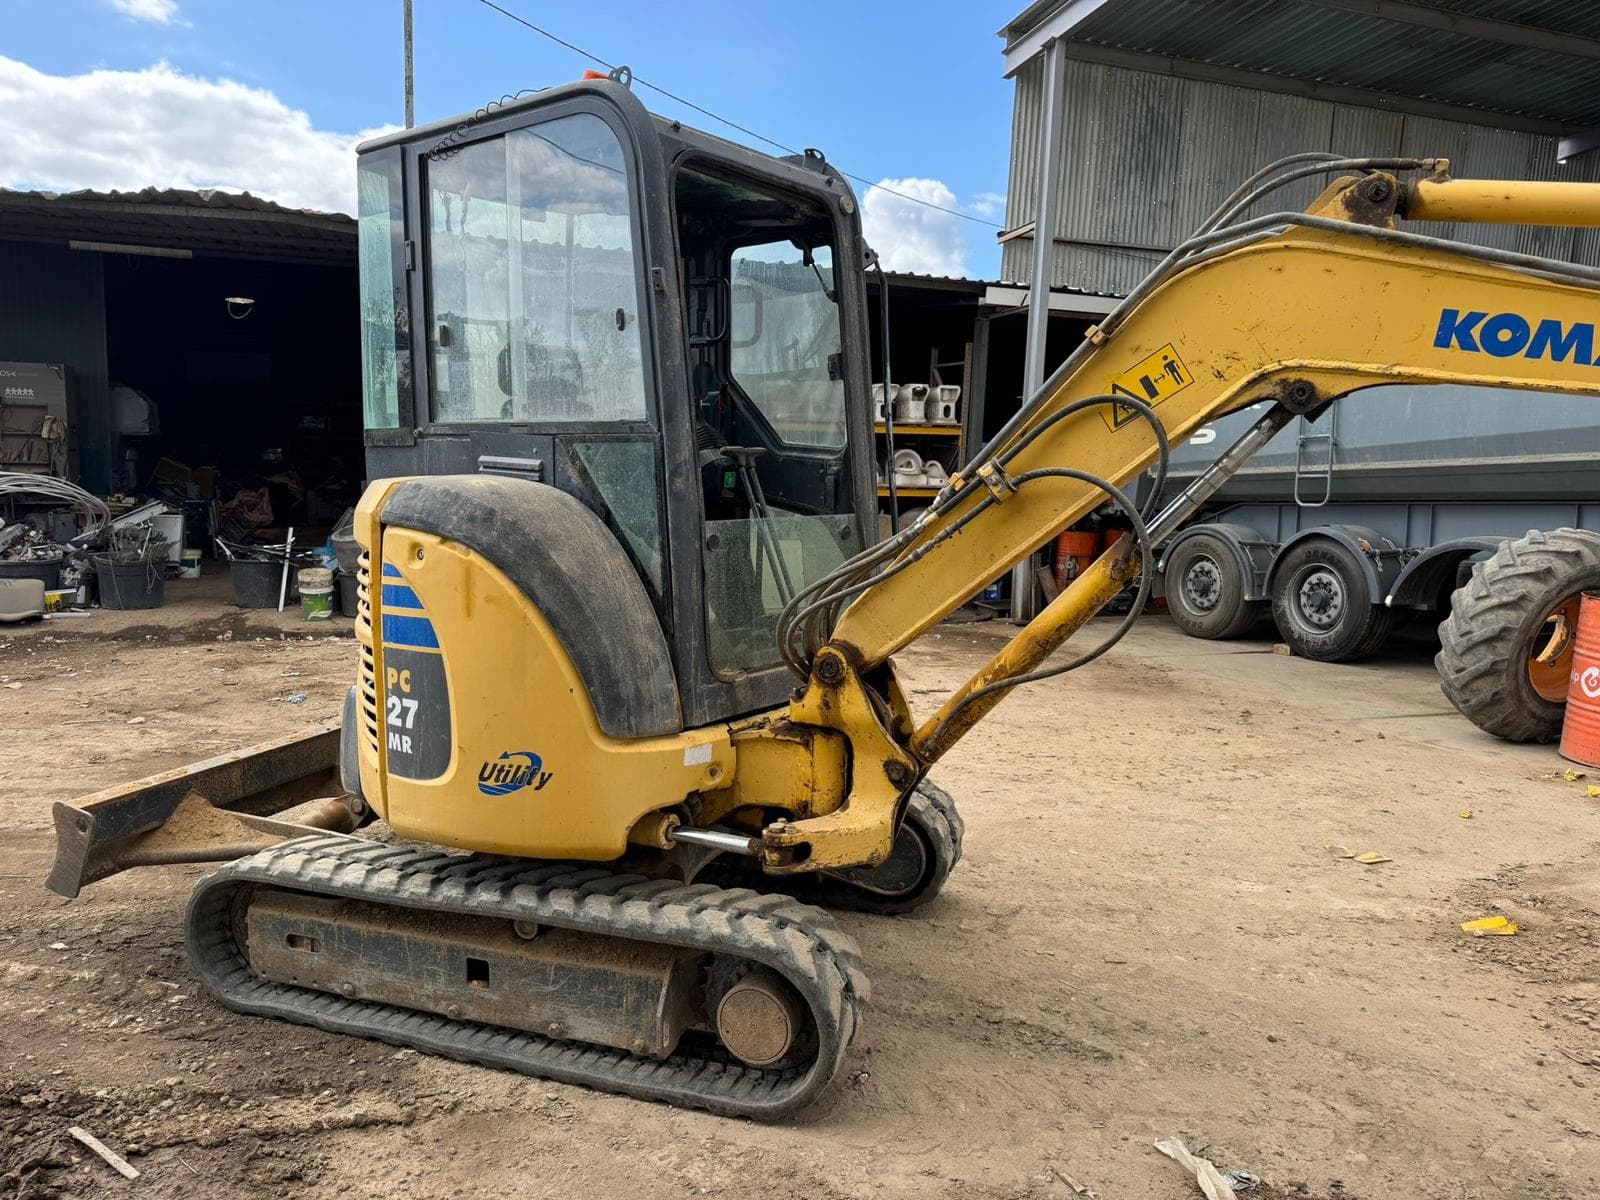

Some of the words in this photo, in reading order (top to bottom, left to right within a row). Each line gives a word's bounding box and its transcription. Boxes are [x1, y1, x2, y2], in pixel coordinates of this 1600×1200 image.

[1433, 308, 1600, 367] KOM
[387, 667, 411, 693] PC
[387, 694, 419, 729] 27
[388, 732, 413, 754] MR
[478, 760, 554, 791] Utility
